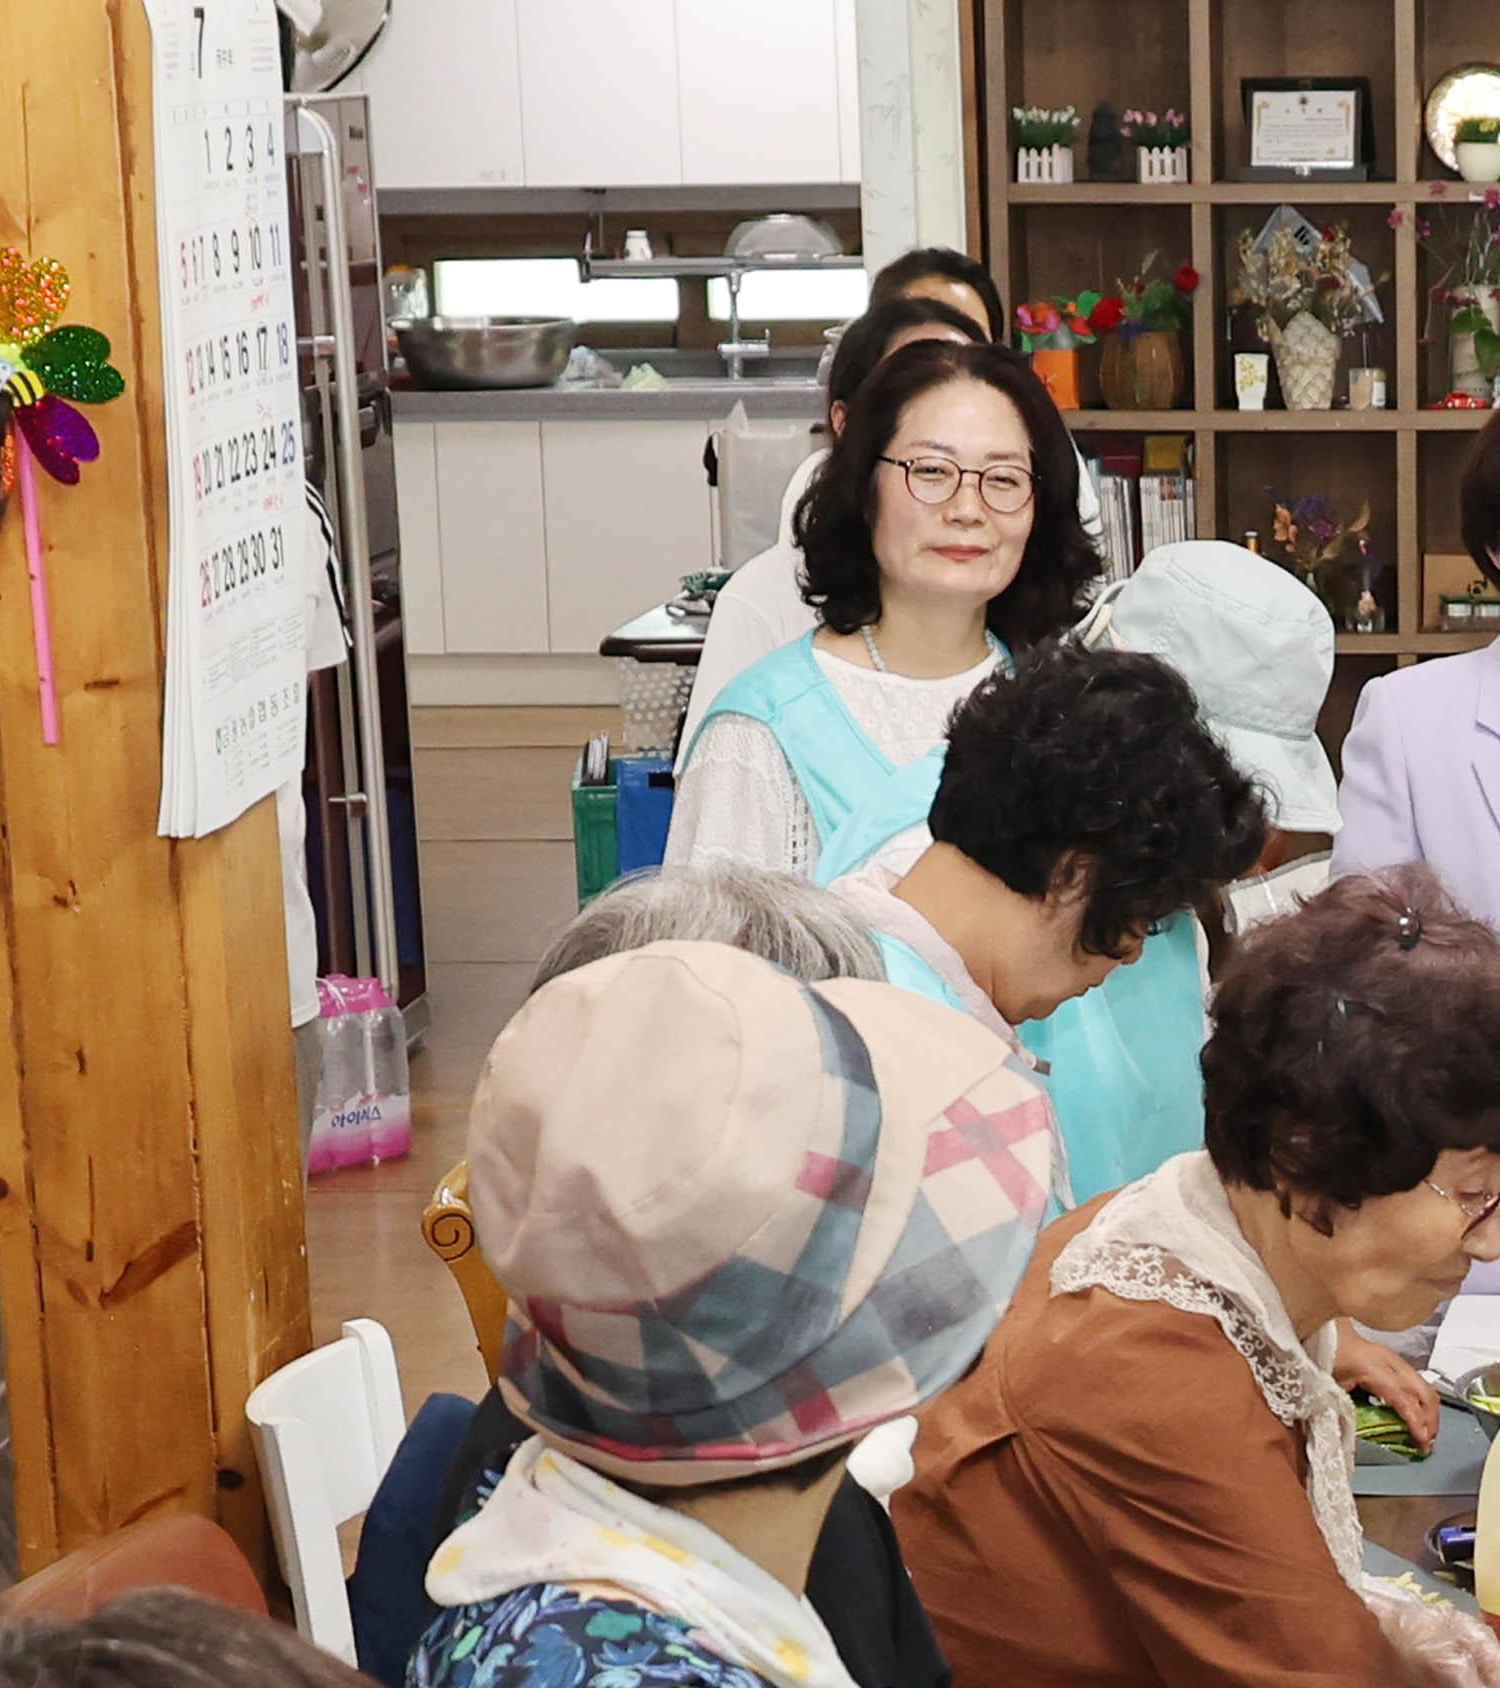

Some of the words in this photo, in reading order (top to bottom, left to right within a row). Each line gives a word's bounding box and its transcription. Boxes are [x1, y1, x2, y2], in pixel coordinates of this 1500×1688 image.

[193, 6, 205, 79] 7
[204, 128, 211, 174] 1
[224, 125, 234, 171] 2
[246, 123, 255, 168] 3
[266, 122, 275, 166] 4
[180, 240, 188, 288] 5
[212, 231, 221, 277] 8
[231, 228, 240, 274] 9
[249, 224, 262, 271] 10
[269, 223, 282, 267] 11
[219, 334, 231, 379] 15
[236, 330, 249, 376] 16
[257, 325, 268, 371] 17
[276, 321, 289, 366] 18
[214, 443, 225, 489] 21
[227, 437, 241, 484] 22
[243, 431, 258, 477] 23
[261, 425, 277, 471] 24
[281, 420, 296, 465] 25
[222, 544, 236, 592] 28
[237, 538, 249, 584] 29
[250, 530, 265, 578] 30
[270, 524, 284, 569] 31
